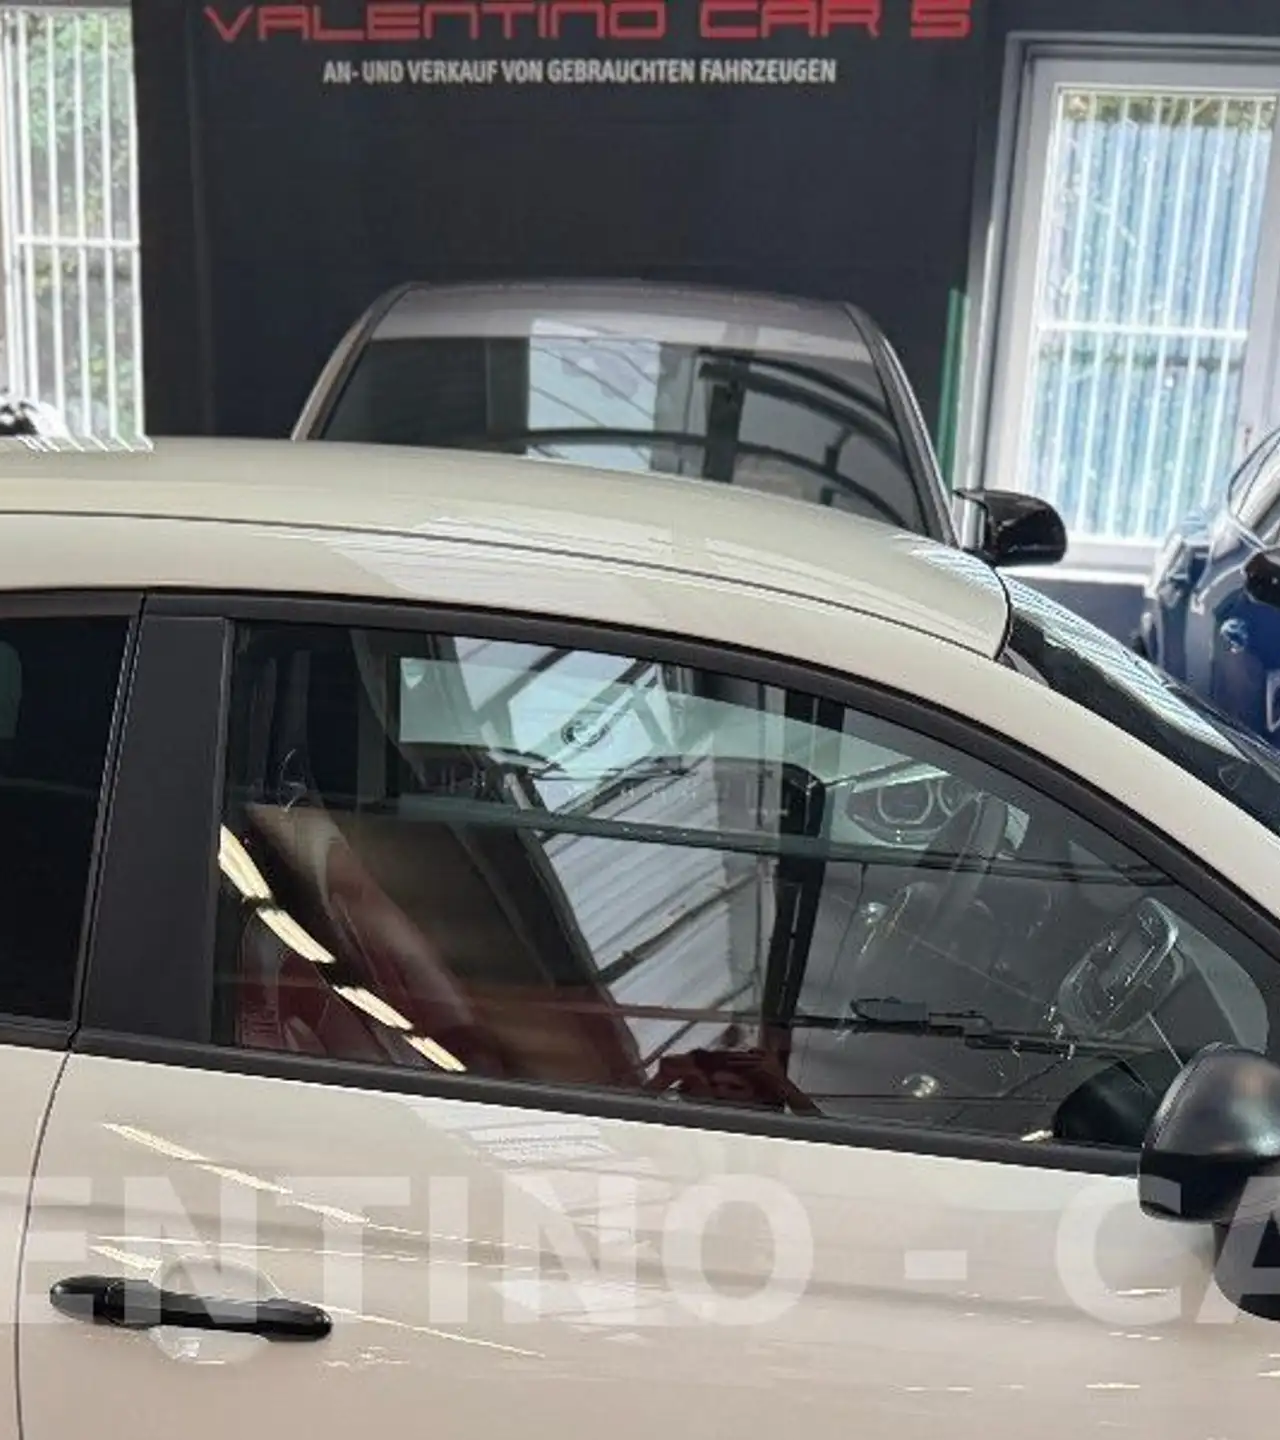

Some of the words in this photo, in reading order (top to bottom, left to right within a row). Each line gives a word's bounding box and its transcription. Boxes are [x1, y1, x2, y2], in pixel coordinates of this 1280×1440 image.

[204, 1, 666, 41] VALENTINO
[322, 61, 358, 84] AN-
[362, 60, 404, 84] UND
[407, 60, 498, 84] VERKAUF
[501, 60, 544, 84] VON
[547, 59, 696, 84] GEBRAUCHTEN
[699, 58, 837, 83] FAHRZEUGEN
